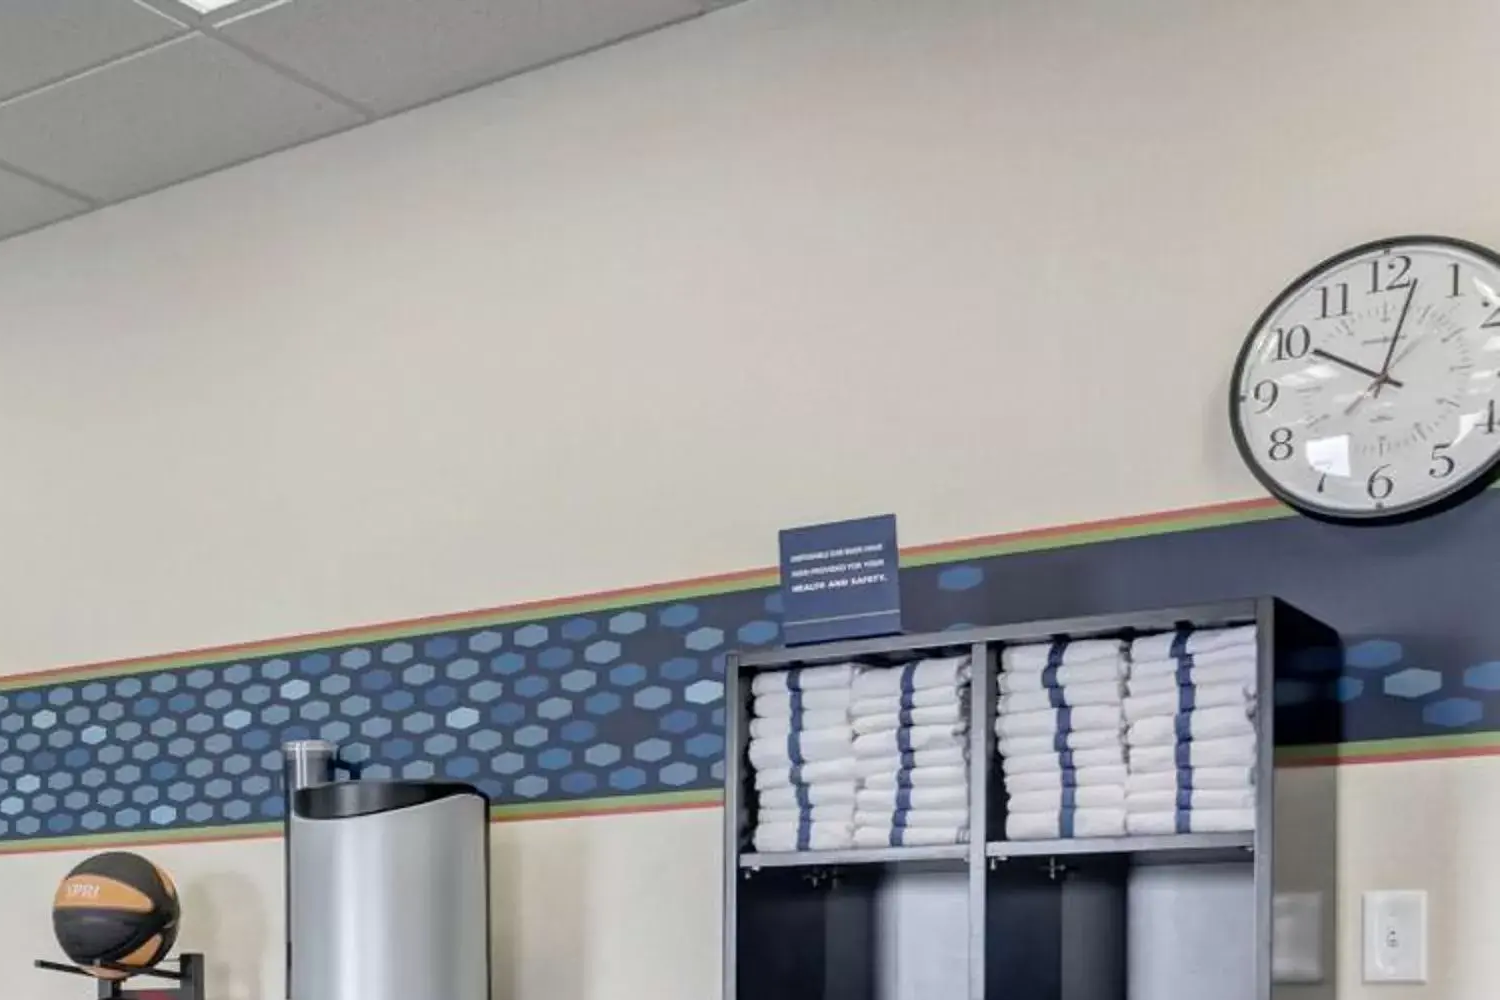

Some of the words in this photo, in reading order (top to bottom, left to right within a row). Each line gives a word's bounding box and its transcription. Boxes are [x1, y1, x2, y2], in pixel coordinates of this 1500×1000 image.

[1366, 254, 1413, 295] 12
[1446, 262, 1465, 298] 1
[1314, 282, 1353, 321] 11
[1271, 323, 1311, 362] 10
[1253, 380, 1279, 414] 9
[1268, 427, 1294, 461] 8
[1428, 443, 1455, 478] 5
[1366, 463, 1394, 499] 6
[65, 882, 101, 898] SPRI
